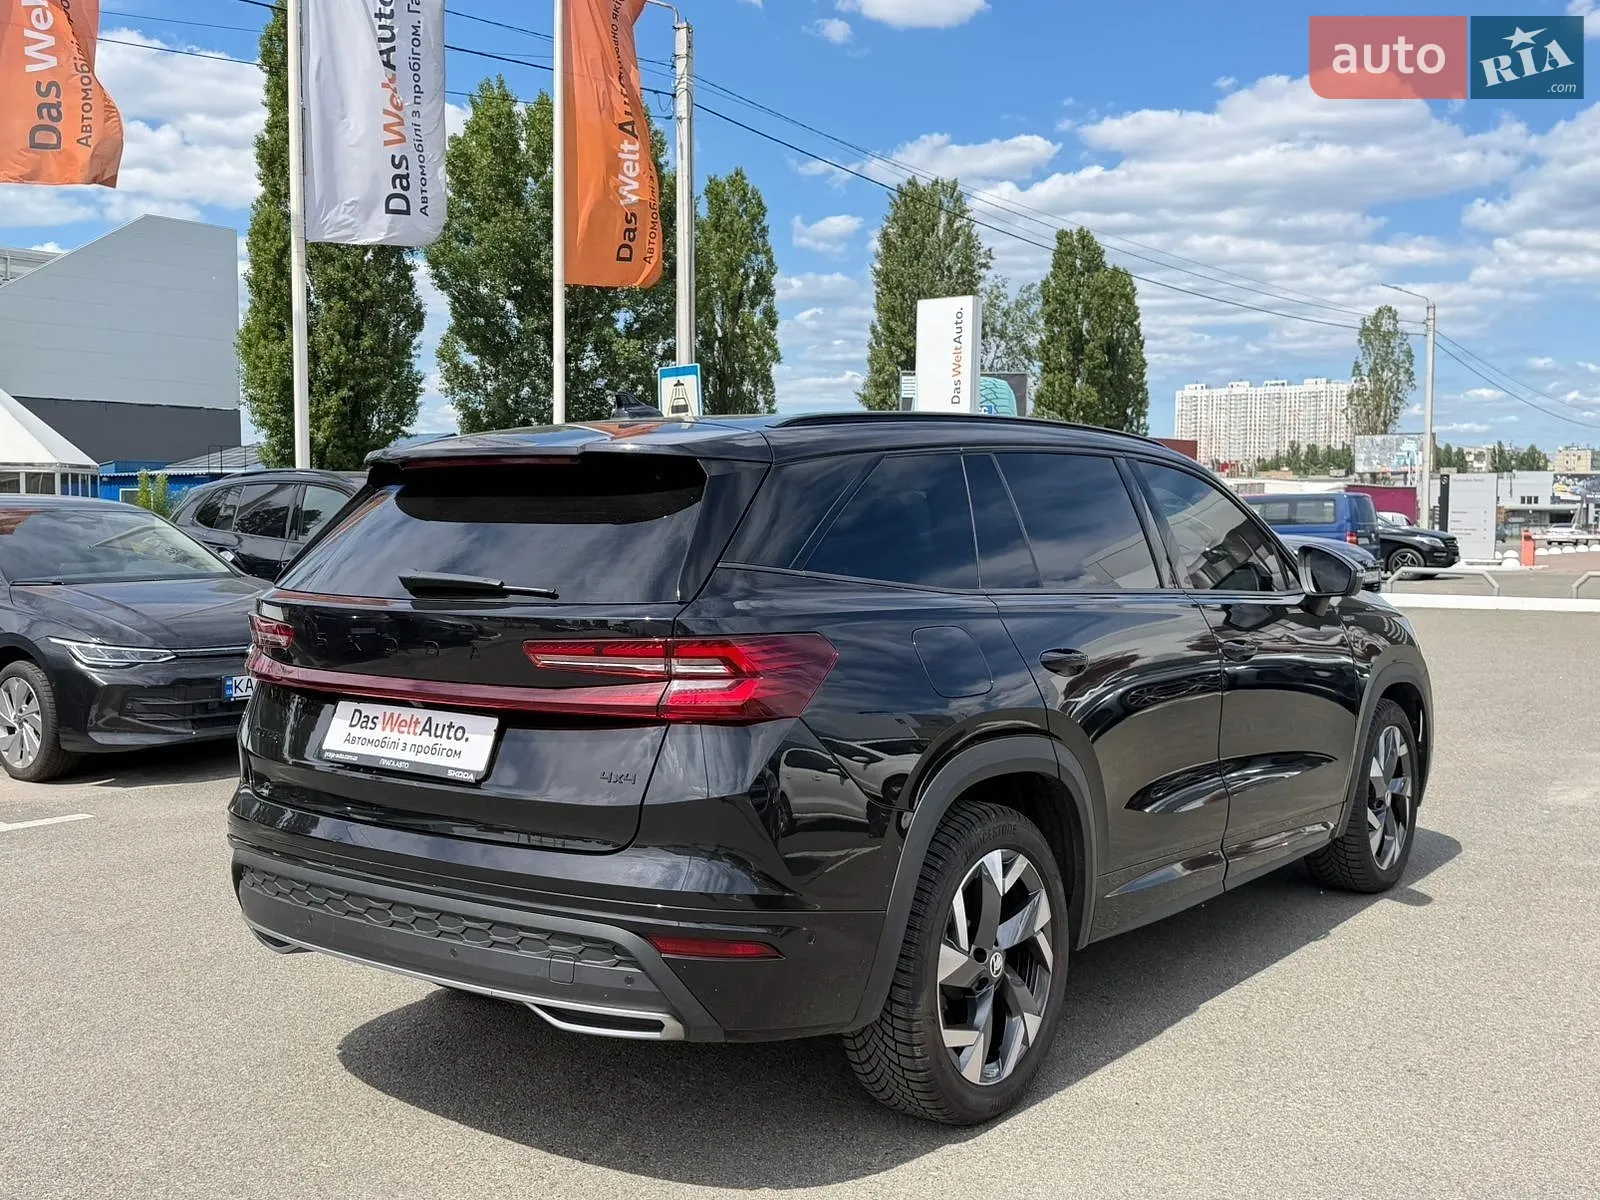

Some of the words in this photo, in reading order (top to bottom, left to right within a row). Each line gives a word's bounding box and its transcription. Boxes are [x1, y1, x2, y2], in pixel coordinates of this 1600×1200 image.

[408, 20, 425, 106] пробігом.
[29, 80, 62, 150] Das
[384, 154, 411, 216] Das
[411, 122, 430, 217] Автомобілі
[616, 211, 638, 262] Das
[951, 307, 964, 378] WeltAuto.
[951, 379, 962, 405] Das
[234, 678, 254, 693] KA
[343, 732, 401, 749] Автомобілі
[400, 741, 408, 752] з
[409, 741, 462, 759] пробігом
[349, 708, 379, 731] Das
[381, 711, 469, 742] WeltAuto.
